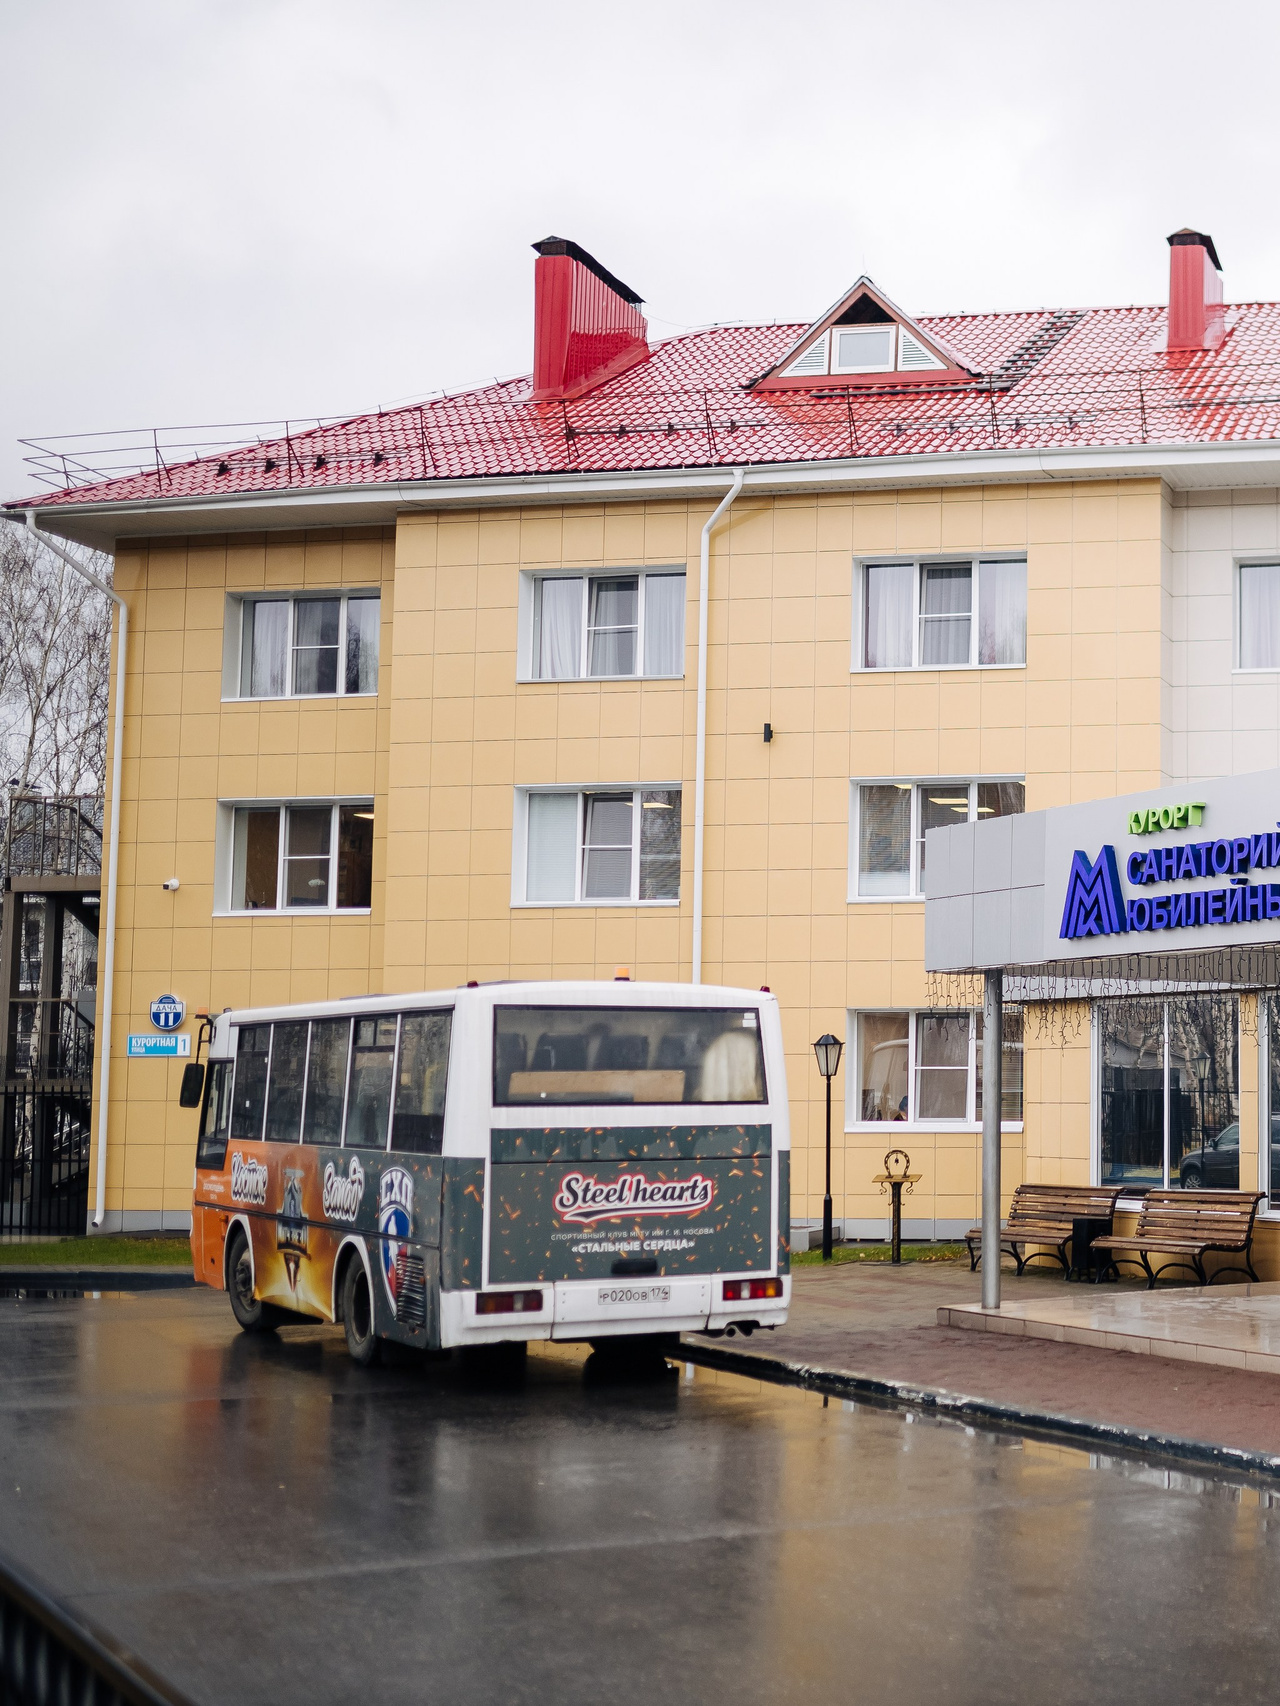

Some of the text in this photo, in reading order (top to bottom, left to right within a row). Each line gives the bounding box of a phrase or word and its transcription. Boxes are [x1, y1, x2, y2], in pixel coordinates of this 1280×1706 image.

[1128, 802, 1206, 835] КУРОРТ
[159, 1012, 174, 1026] 11
[131, 1037, 186, 1052] КУРОРТНАЯ 1
[556, 1174, 711, 1210] Steel hearts
[551, 1230, 606, 1241] СПОРТИВНЫЙ
[608, 1230, 628, 1239] КЛУБ
[683, 1227, 714, 1235] НОСОВА
[571, 1238, 695, 1253] «СТАЛЬНЫЕ СЕРДЦА»
